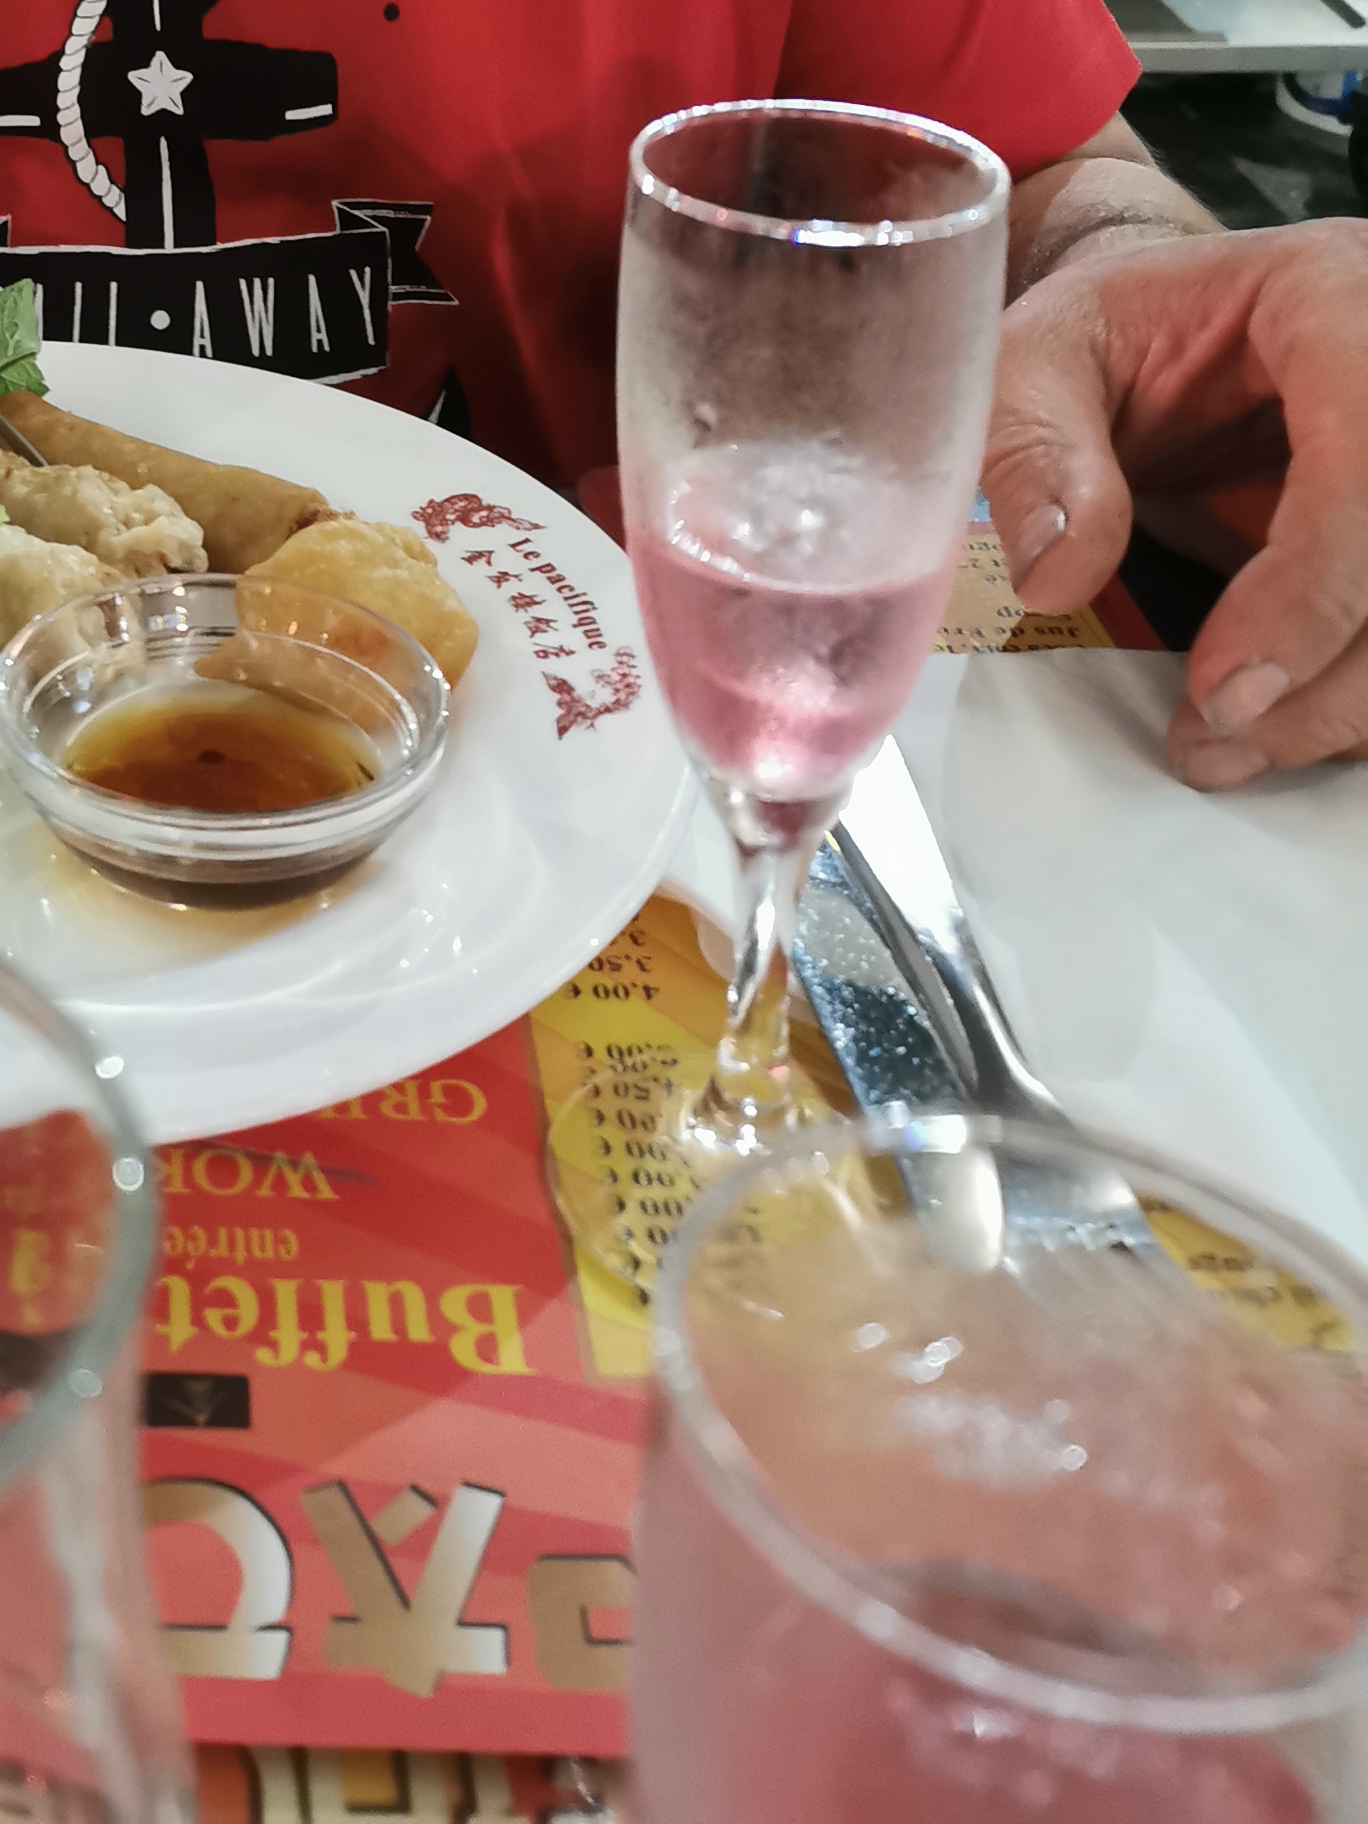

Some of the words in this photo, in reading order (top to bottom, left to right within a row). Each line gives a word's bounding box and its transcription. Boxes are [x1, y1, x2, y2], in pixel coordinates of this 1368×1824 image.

[192, 265, 376, 358] AWAY
[507, 537, 542, 562] Le
[527, 561, 608, 650] pacifique
[163, 1226, 299, 1270] entrée
[154, 1275, 537, 1377] Buffet
